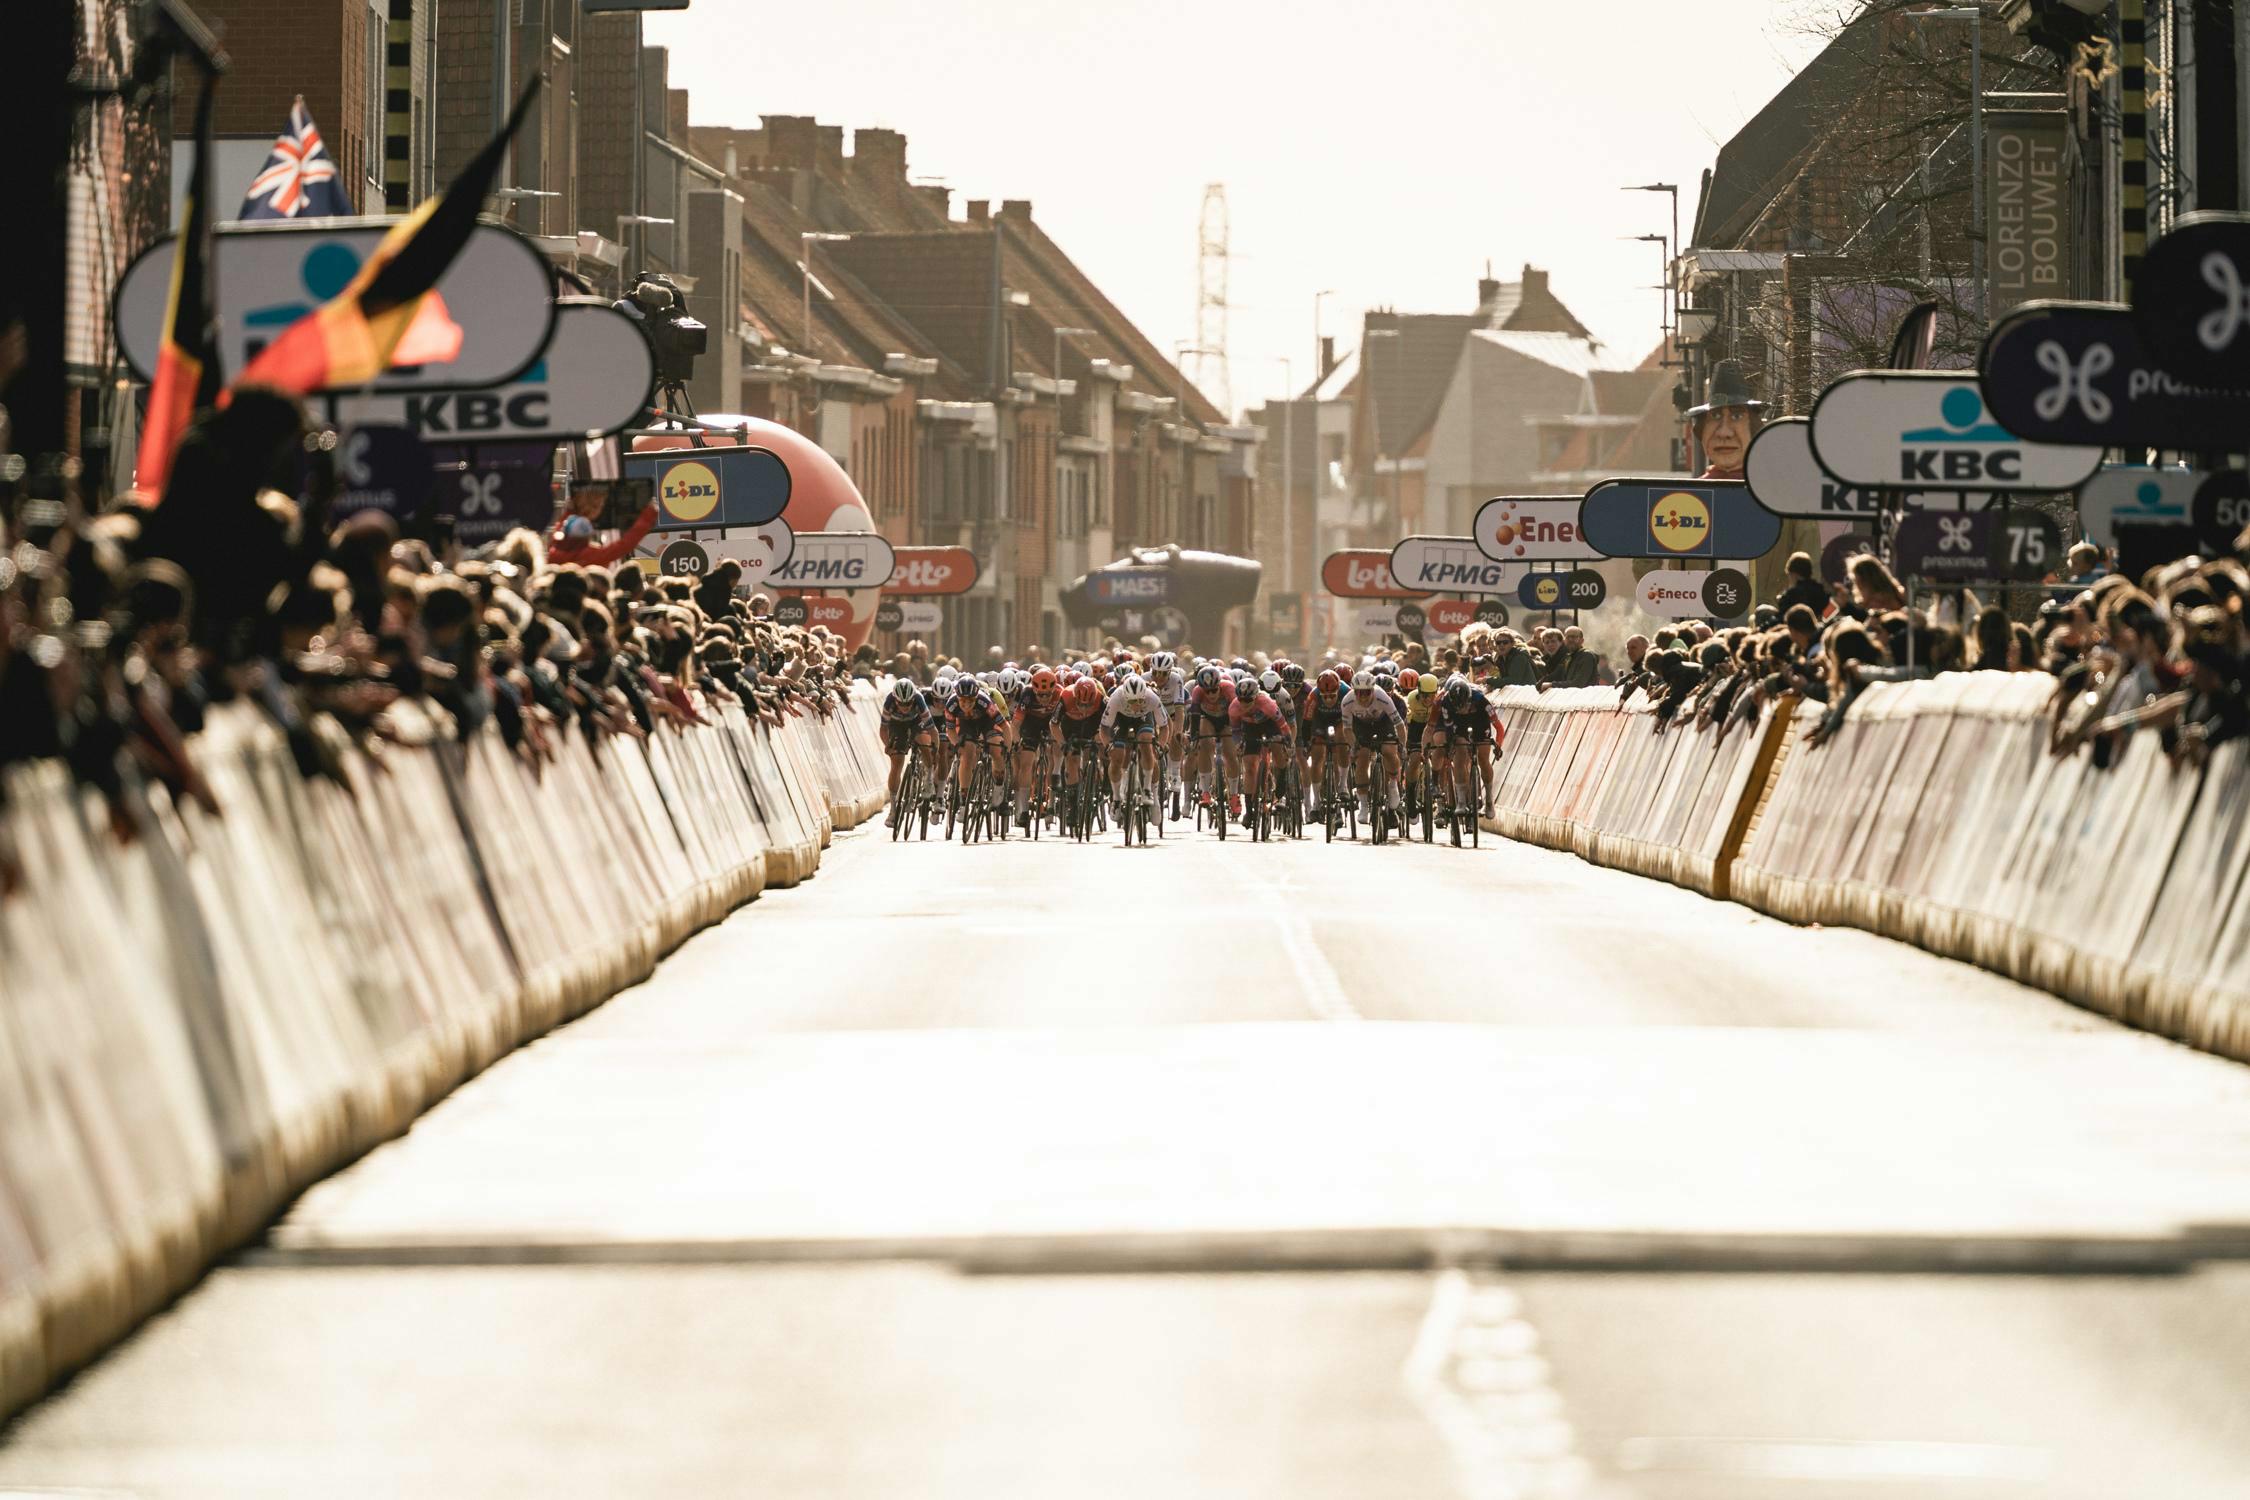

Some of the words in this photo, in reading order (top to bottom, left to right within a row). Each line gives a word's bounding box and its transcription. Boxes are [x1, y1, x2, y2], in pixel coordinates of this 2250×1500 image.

[1998, 135, 2025, 288] LORENZO
[2031, 139, 2058, 283] BOUWET
[404, 393, 549, 432] KBC
[1901, 449, 2021, 481] KBC
[2216, 498, 2250, 526] 50
[1520, 516, 1585, 542] Ene
[2007, 526, 2046, 564] 75
[670, 556, 700, 573] 150
[740, 558, 762, 568] eco
[781, 558, 864, 580] KPMG
[882, 560, 952, 587] otto
[1347, 559, 1399, 590] lot
[1418, 563, 1502, 586] KPMG
[1111, 579, 1160, 597] MAES
[1571, 583, 1598, 596] 200
[1657, 588, 1697, 599] Eneco
[779, 607, 803, 619] 250
[877, 612, 900, 623] 300
[1400, 614, 1422, 625] 300
[1479, 612, 1503, 625] 250
